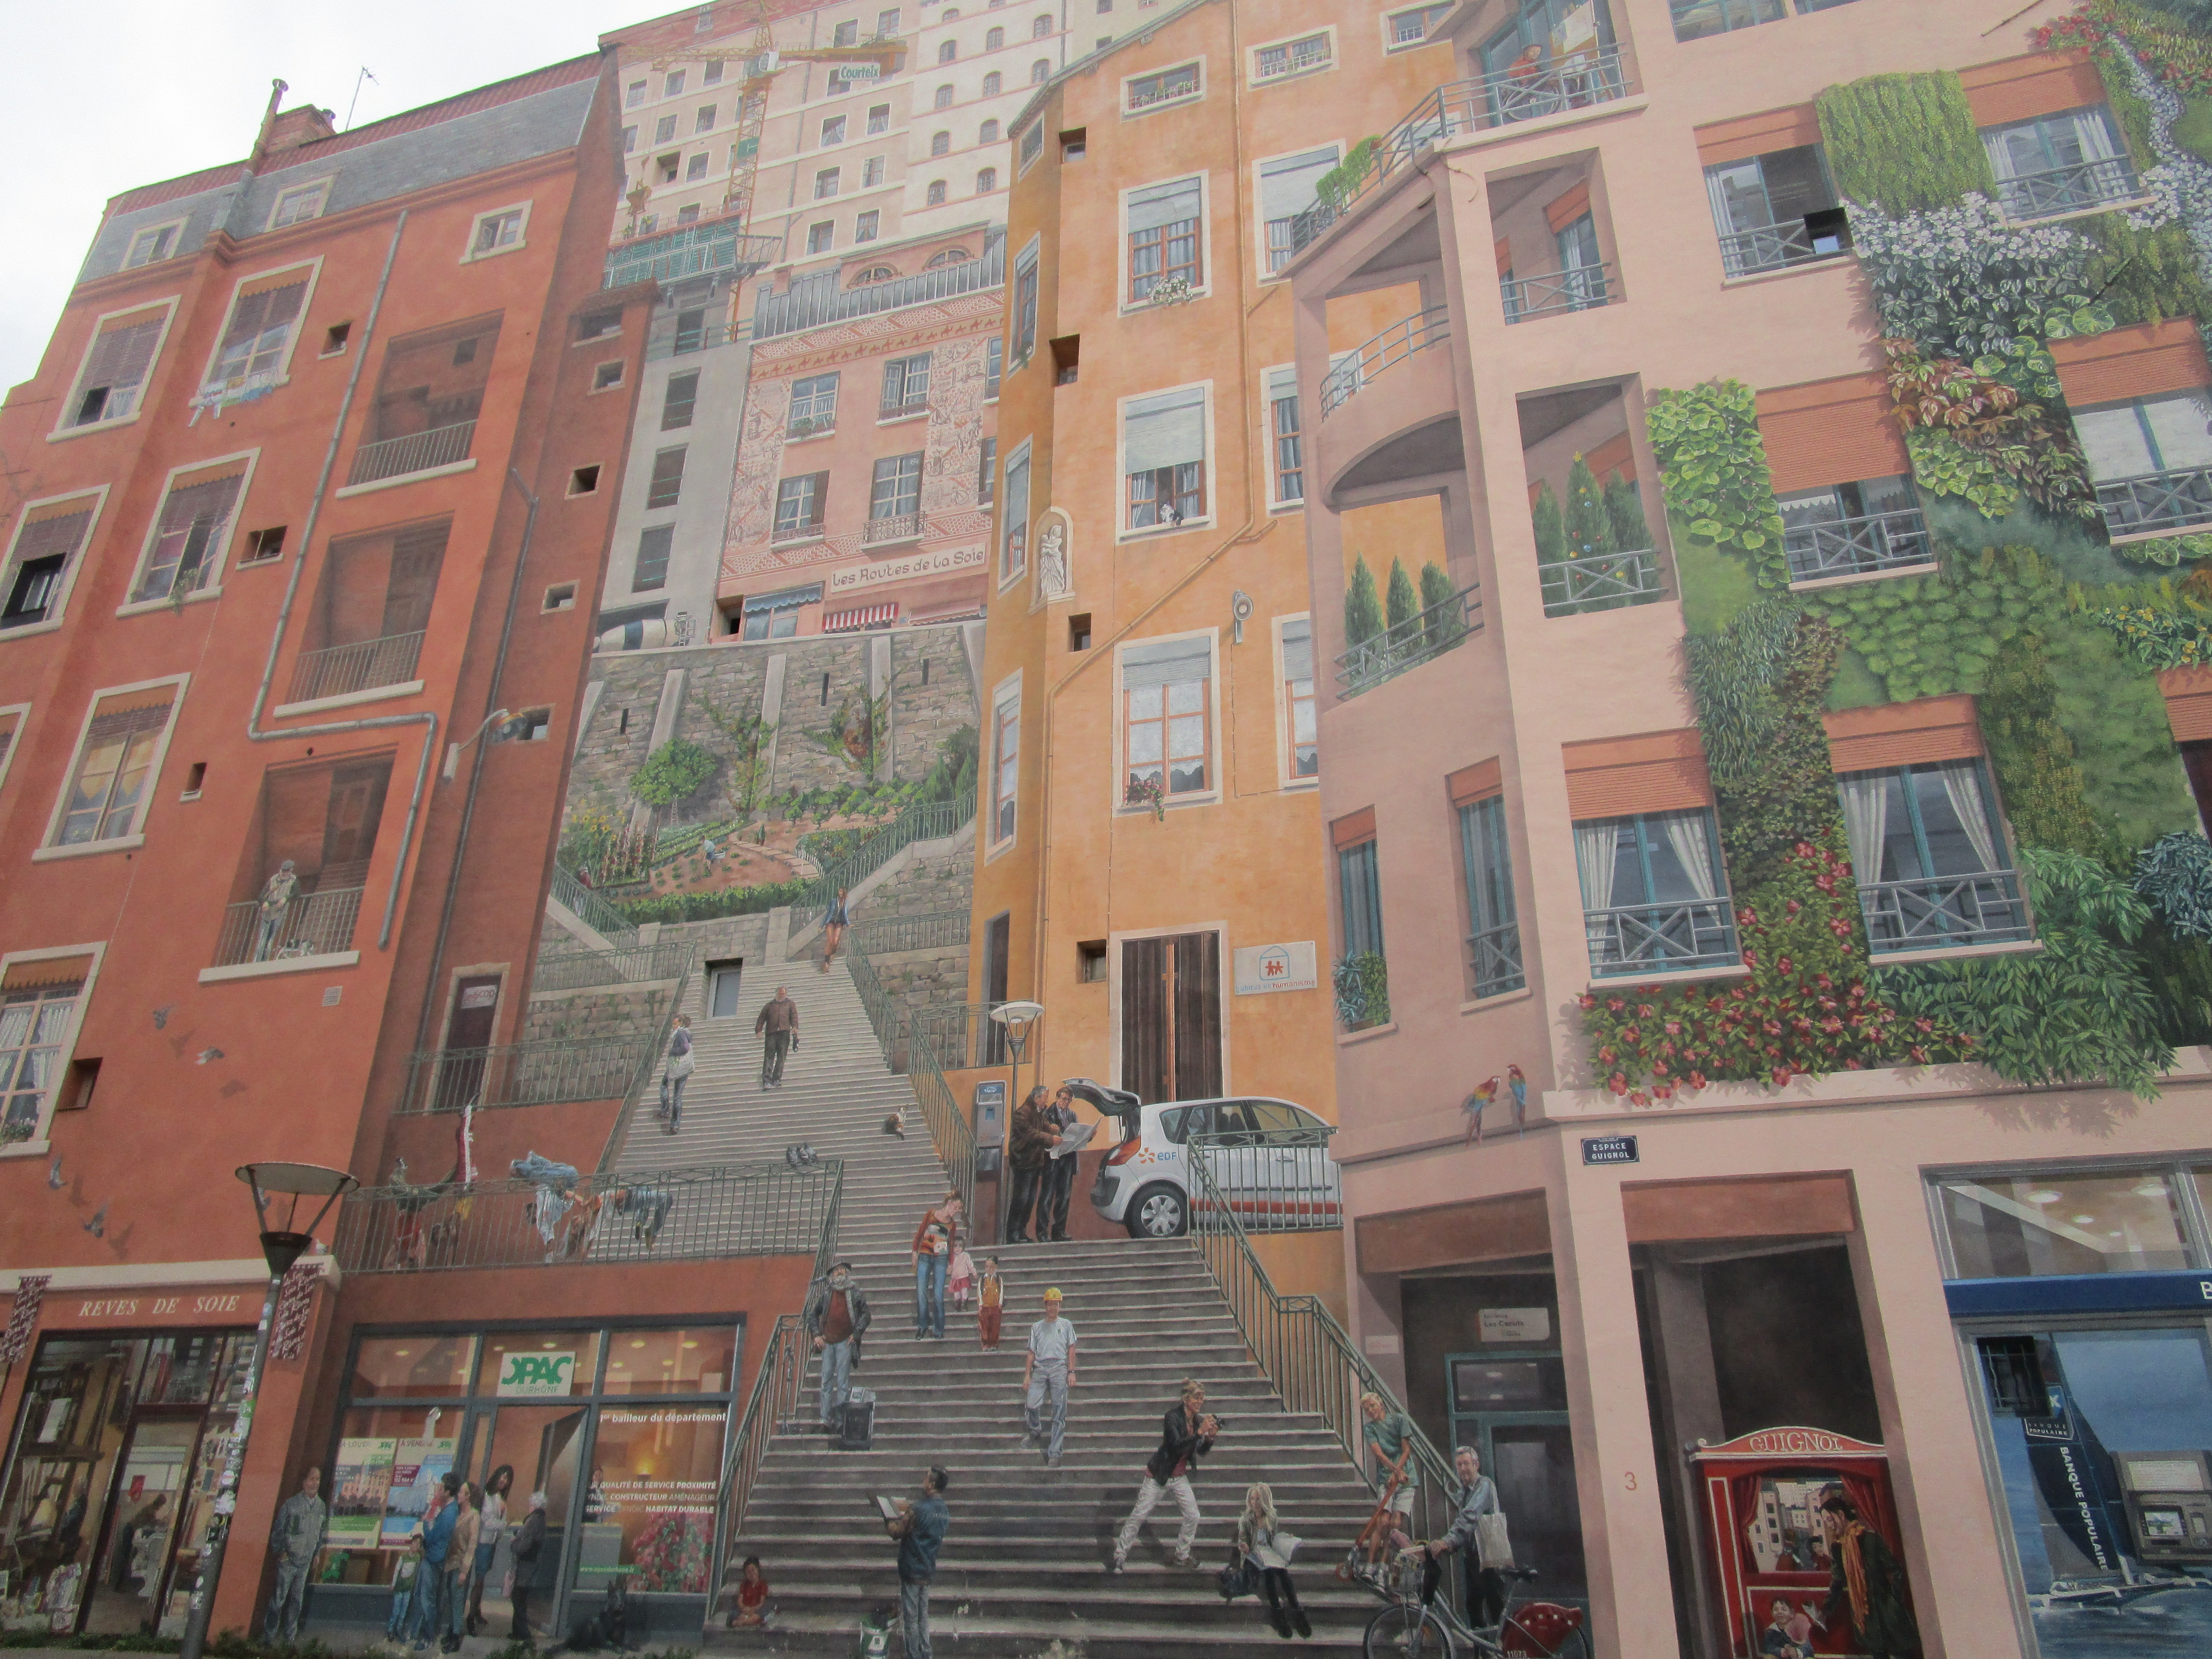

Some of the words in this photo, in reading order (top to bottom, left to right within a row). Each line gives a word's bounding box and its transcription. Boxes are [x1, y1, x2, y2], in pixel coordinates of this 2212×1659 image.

[860, 564, 910, 582] Routes
[913, 558, 930, 572] de
[953, 548, 984, 565] Soie
[1235, 984, 1261, 992] habitat
[1273, 979, 1316, 988] humanisme
[1592, 1142, 1626, 1151] ESPACE
[1592, 1151, 1630, 1160] GUIGNOL
[78, 1298, 139, 1317] REVES
[152, 1297, 180, 1314] DE
[193, 1295, 240, 1314] SOIE
[612, 1413, 648, 1423] bailleur
[650, 1413, 662, 1422] du
[665, 1412, 727, 1424] département
[2029, 1428, 2068, 1436] POPULAIRE
[1750, 1432, 1843, 1453] GUIGNOL
[2060, 1446, 2084, 1498] BANQUE
[600, 1481, 632, 1490] QUALITÉ
[676, 1480, 716, 1489] PROXIMITÉ
[1624, 1471, 1637, 1491] 3
[668, 1492, 716, 1501] AMÉNAGEUR
[645, 1505, 678, 1513] HABITAT
[678, 1505, 715, 1513] DURABLE
[2078, 1501, 2109, 1571] POPULAIRE
